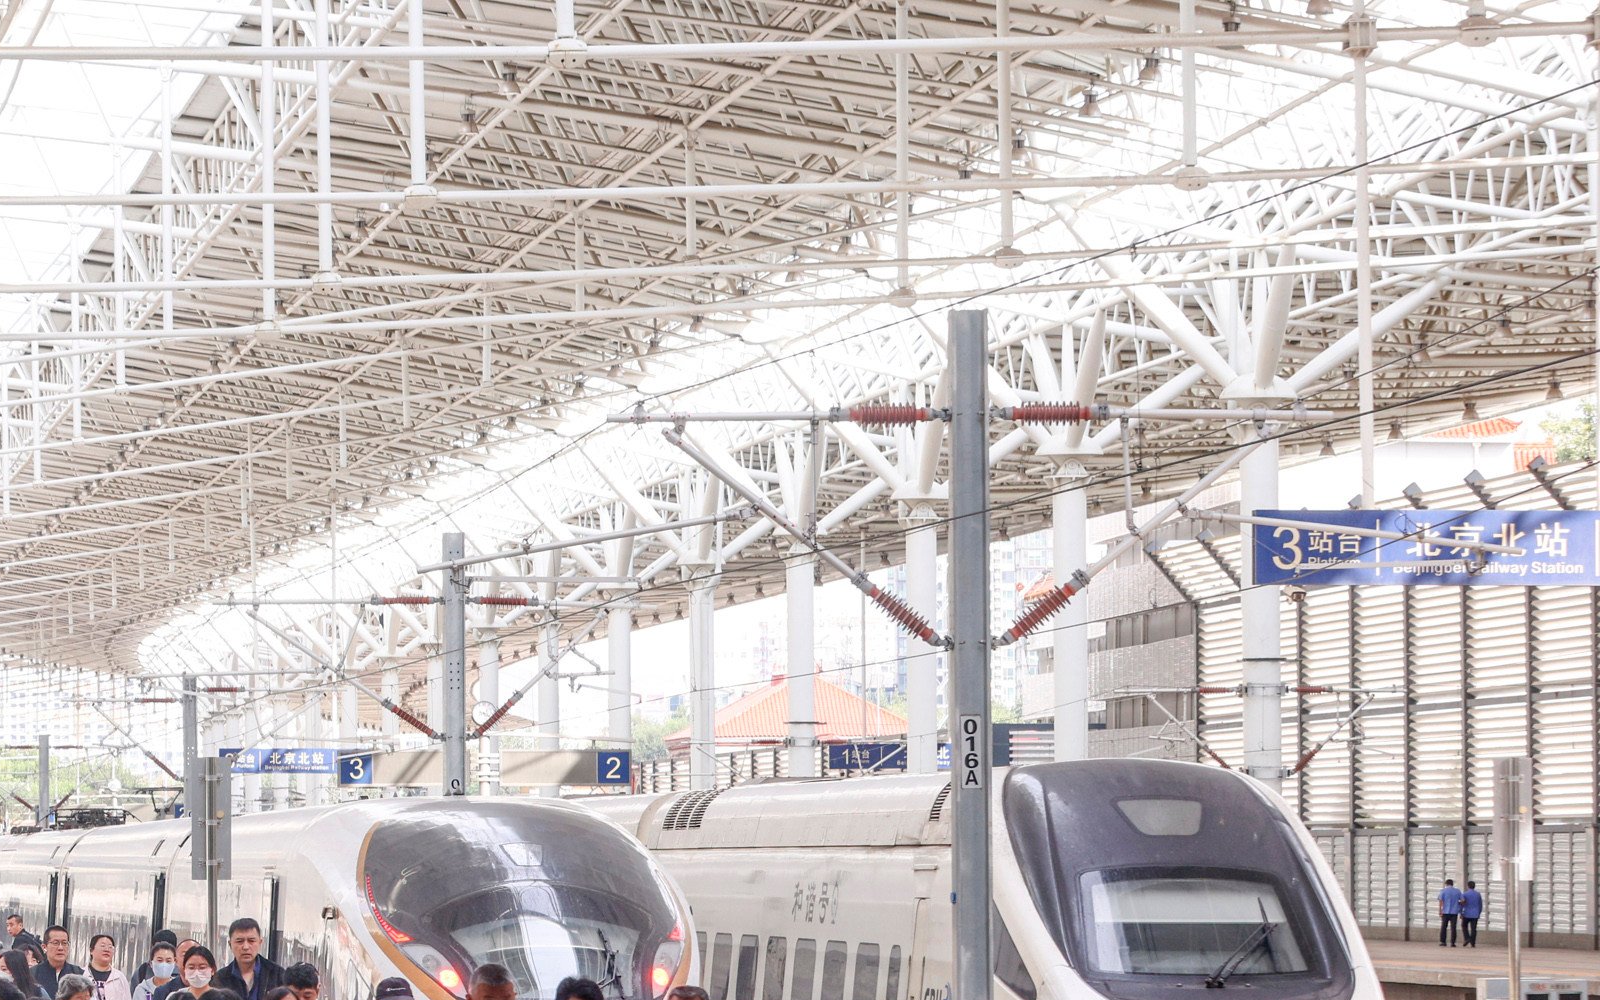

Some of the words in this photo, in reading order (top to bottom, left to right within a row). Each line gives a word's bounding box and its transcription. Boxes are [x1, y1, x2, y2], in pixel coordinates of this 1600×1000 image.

[1272, 525, 1302, 570] 3
[1308, 529, 1362, 554] 站台
[1406, 521, 1570, 557] 北京北站
[1531, 560, 1584, 574] Station
[270, 752, 325, 765] 北京北站
[842, 749, 849, 765] 1
[963, 718, 979, 786] 016A
[349, 758, 364, 780] 3
[606, 756, 621, 780] 2
[792, 881, 830, 924] 和谐号
